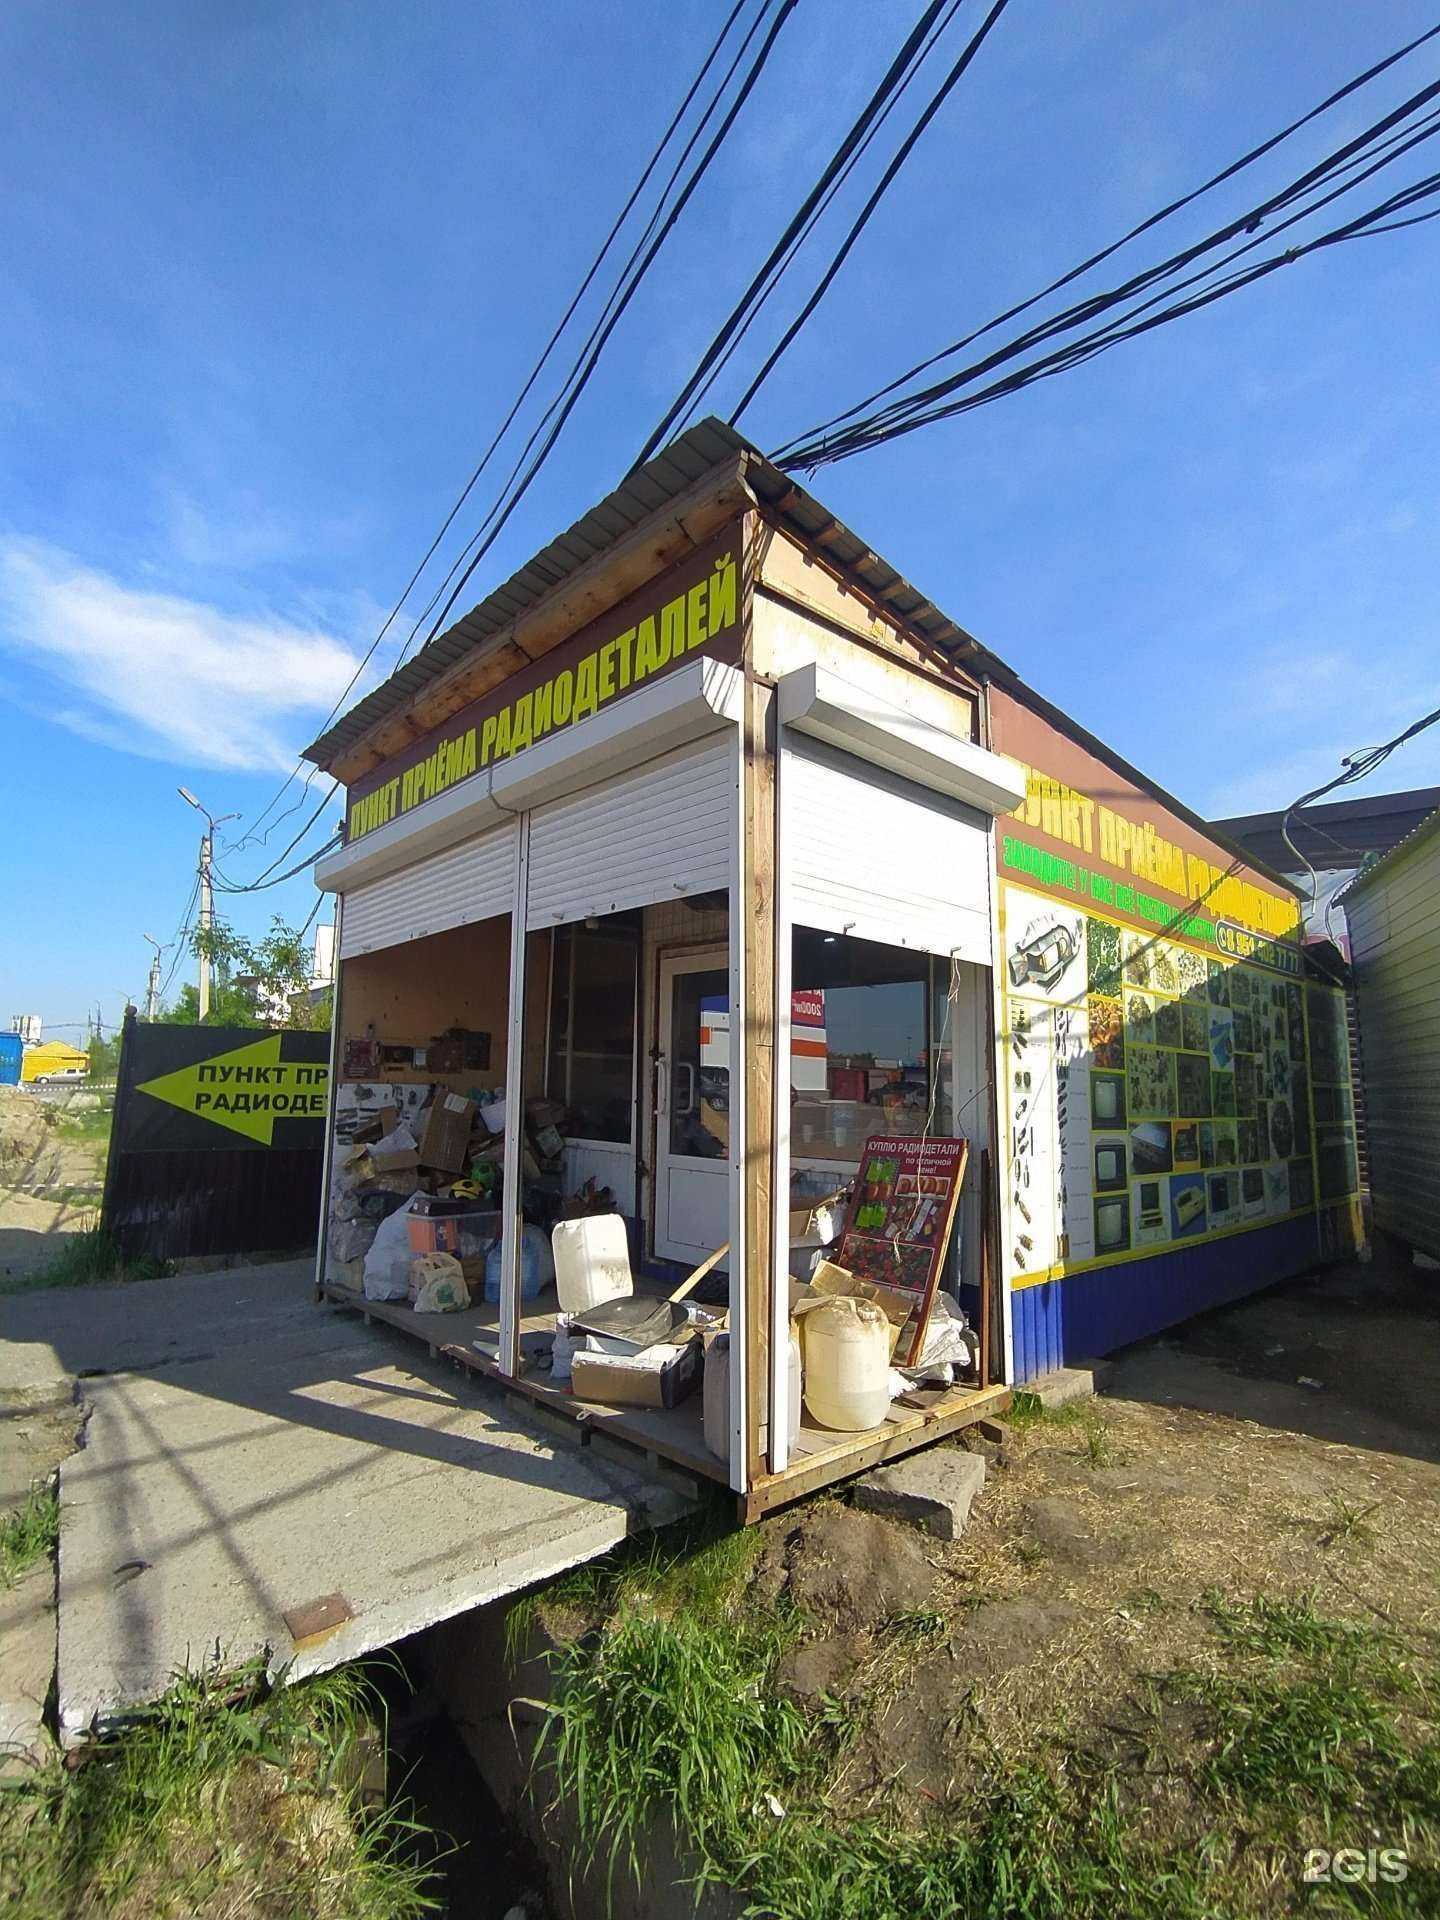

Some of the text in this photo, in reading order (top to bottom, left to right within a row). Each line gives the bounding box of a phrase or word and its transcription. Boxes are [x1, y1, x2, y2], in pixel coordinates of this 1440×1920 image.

[350, 551, 737, 841] ПУНКТ ПРИЁМА РАДИОДЕТАЛЕЙ
[198, 1065, 288, 1084] ПУНКТ
[195, 1093, 329, 1114] РАДИОДЕ
[867, 1141, 960, 1155] КУПЛЮ РАДИОДЕТАЛИ
